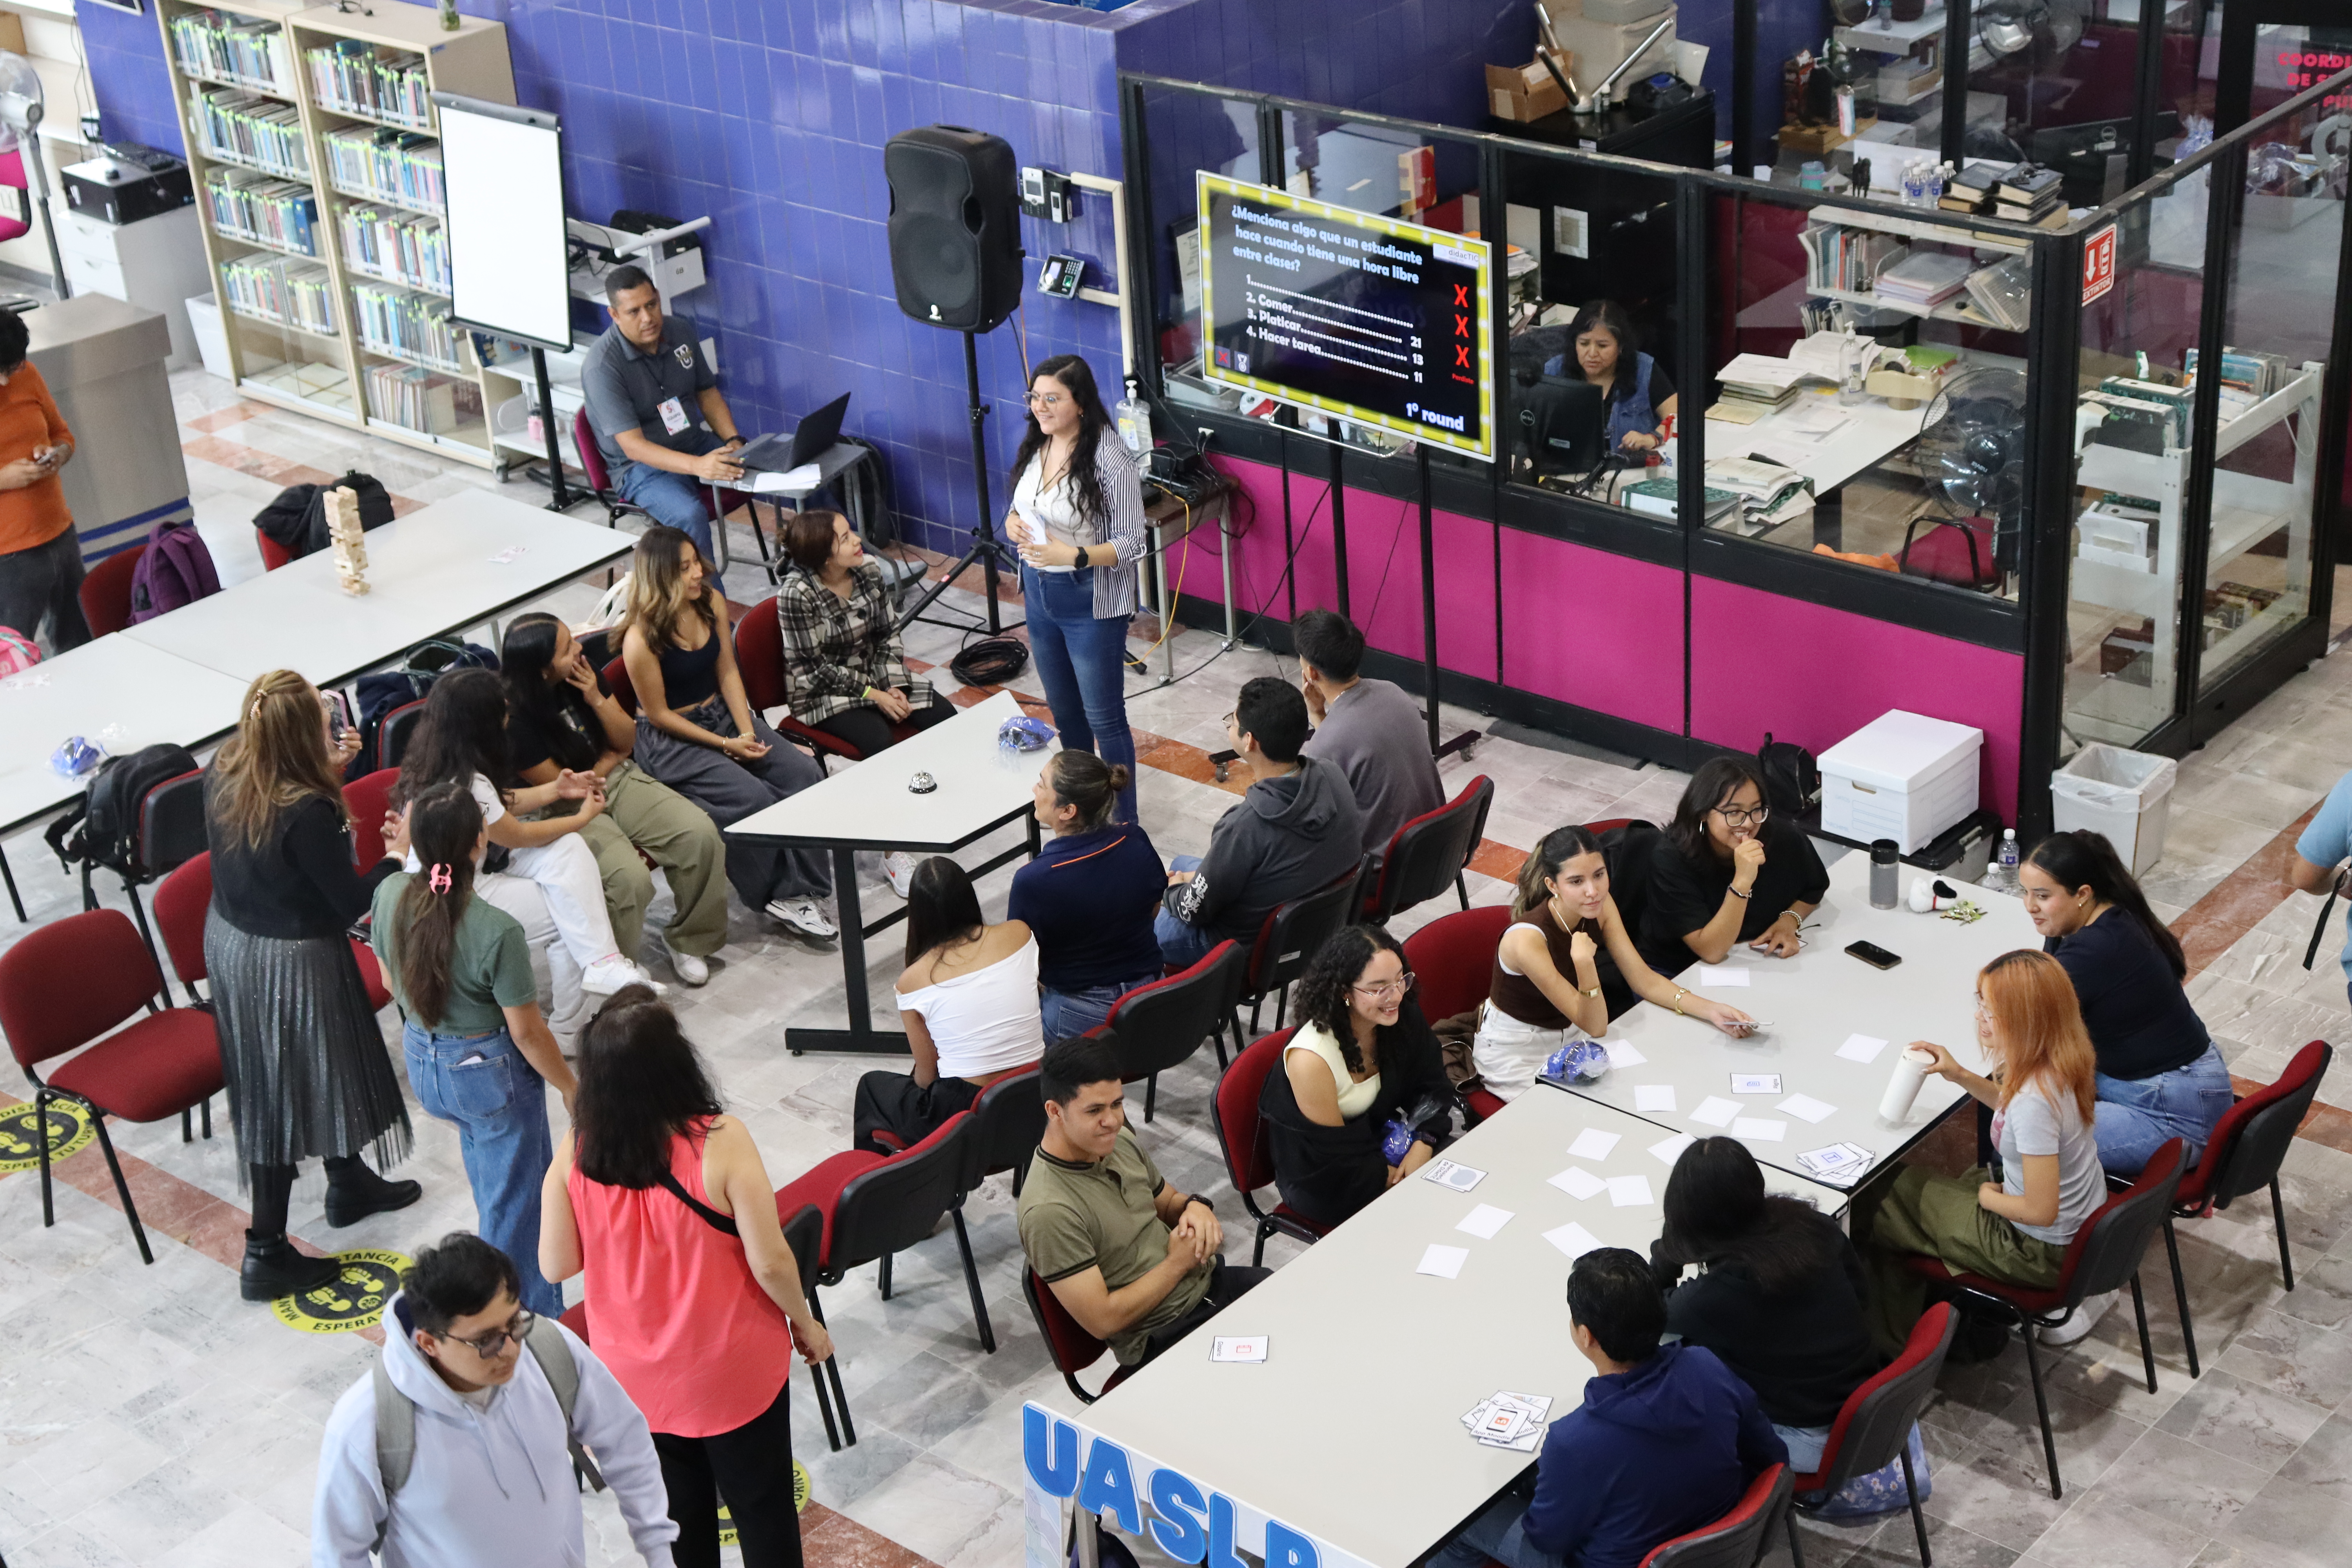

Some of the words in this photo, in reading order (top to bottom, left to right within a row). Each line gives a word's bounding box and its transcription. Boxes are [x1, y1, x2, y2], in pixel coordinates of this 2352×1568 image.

[2278, 53, 2352, 69] COORDI
[2287, 73, 2311, 86] DE
[1232, 204, 1289, 231] ¿Menciona
[1292, 221, 1317, 238] algo
[1319, 230, 1341, 244] que
[1343, 236, 1358, 249] un
[1361, 241, 1422, 265] estudiante
[1233, 246, 1262, 262] entre
[1264, 252, 1301, 272] clases?
[1235, 224, 1261, 243] hace
[1263, 235, 1305, 254] cuando
[1307, 243, 1335, 262] tiene
[1338, 254, 1360, 269] una
[1363, 257, 1389, 277] hora
[1392, 265, 1419, 284] libre
[2084, 277, 2111, 299] EXTINTOR
[1410, 336, 1422, 348] 21
[1258, 327, 1290, 347] Hacer
[1414, 371, 1423, 383] 11
[1412, 353, 1424, 366] 13
[1422, 408, 1464, 432] round
[0, 1102, 80, 1118] DISTNCIA
[1804, 1156, 1819, 1169] Etiqueta
[337, 1252, 399, 1266] TANCIA
[276, 1298, 301, 1321] MAN
[312, 1316, 378, 1330] ESPERA
[1516, 1426, 1534, 1435] oodle
[793, 1470, 804, 1507] URNO
